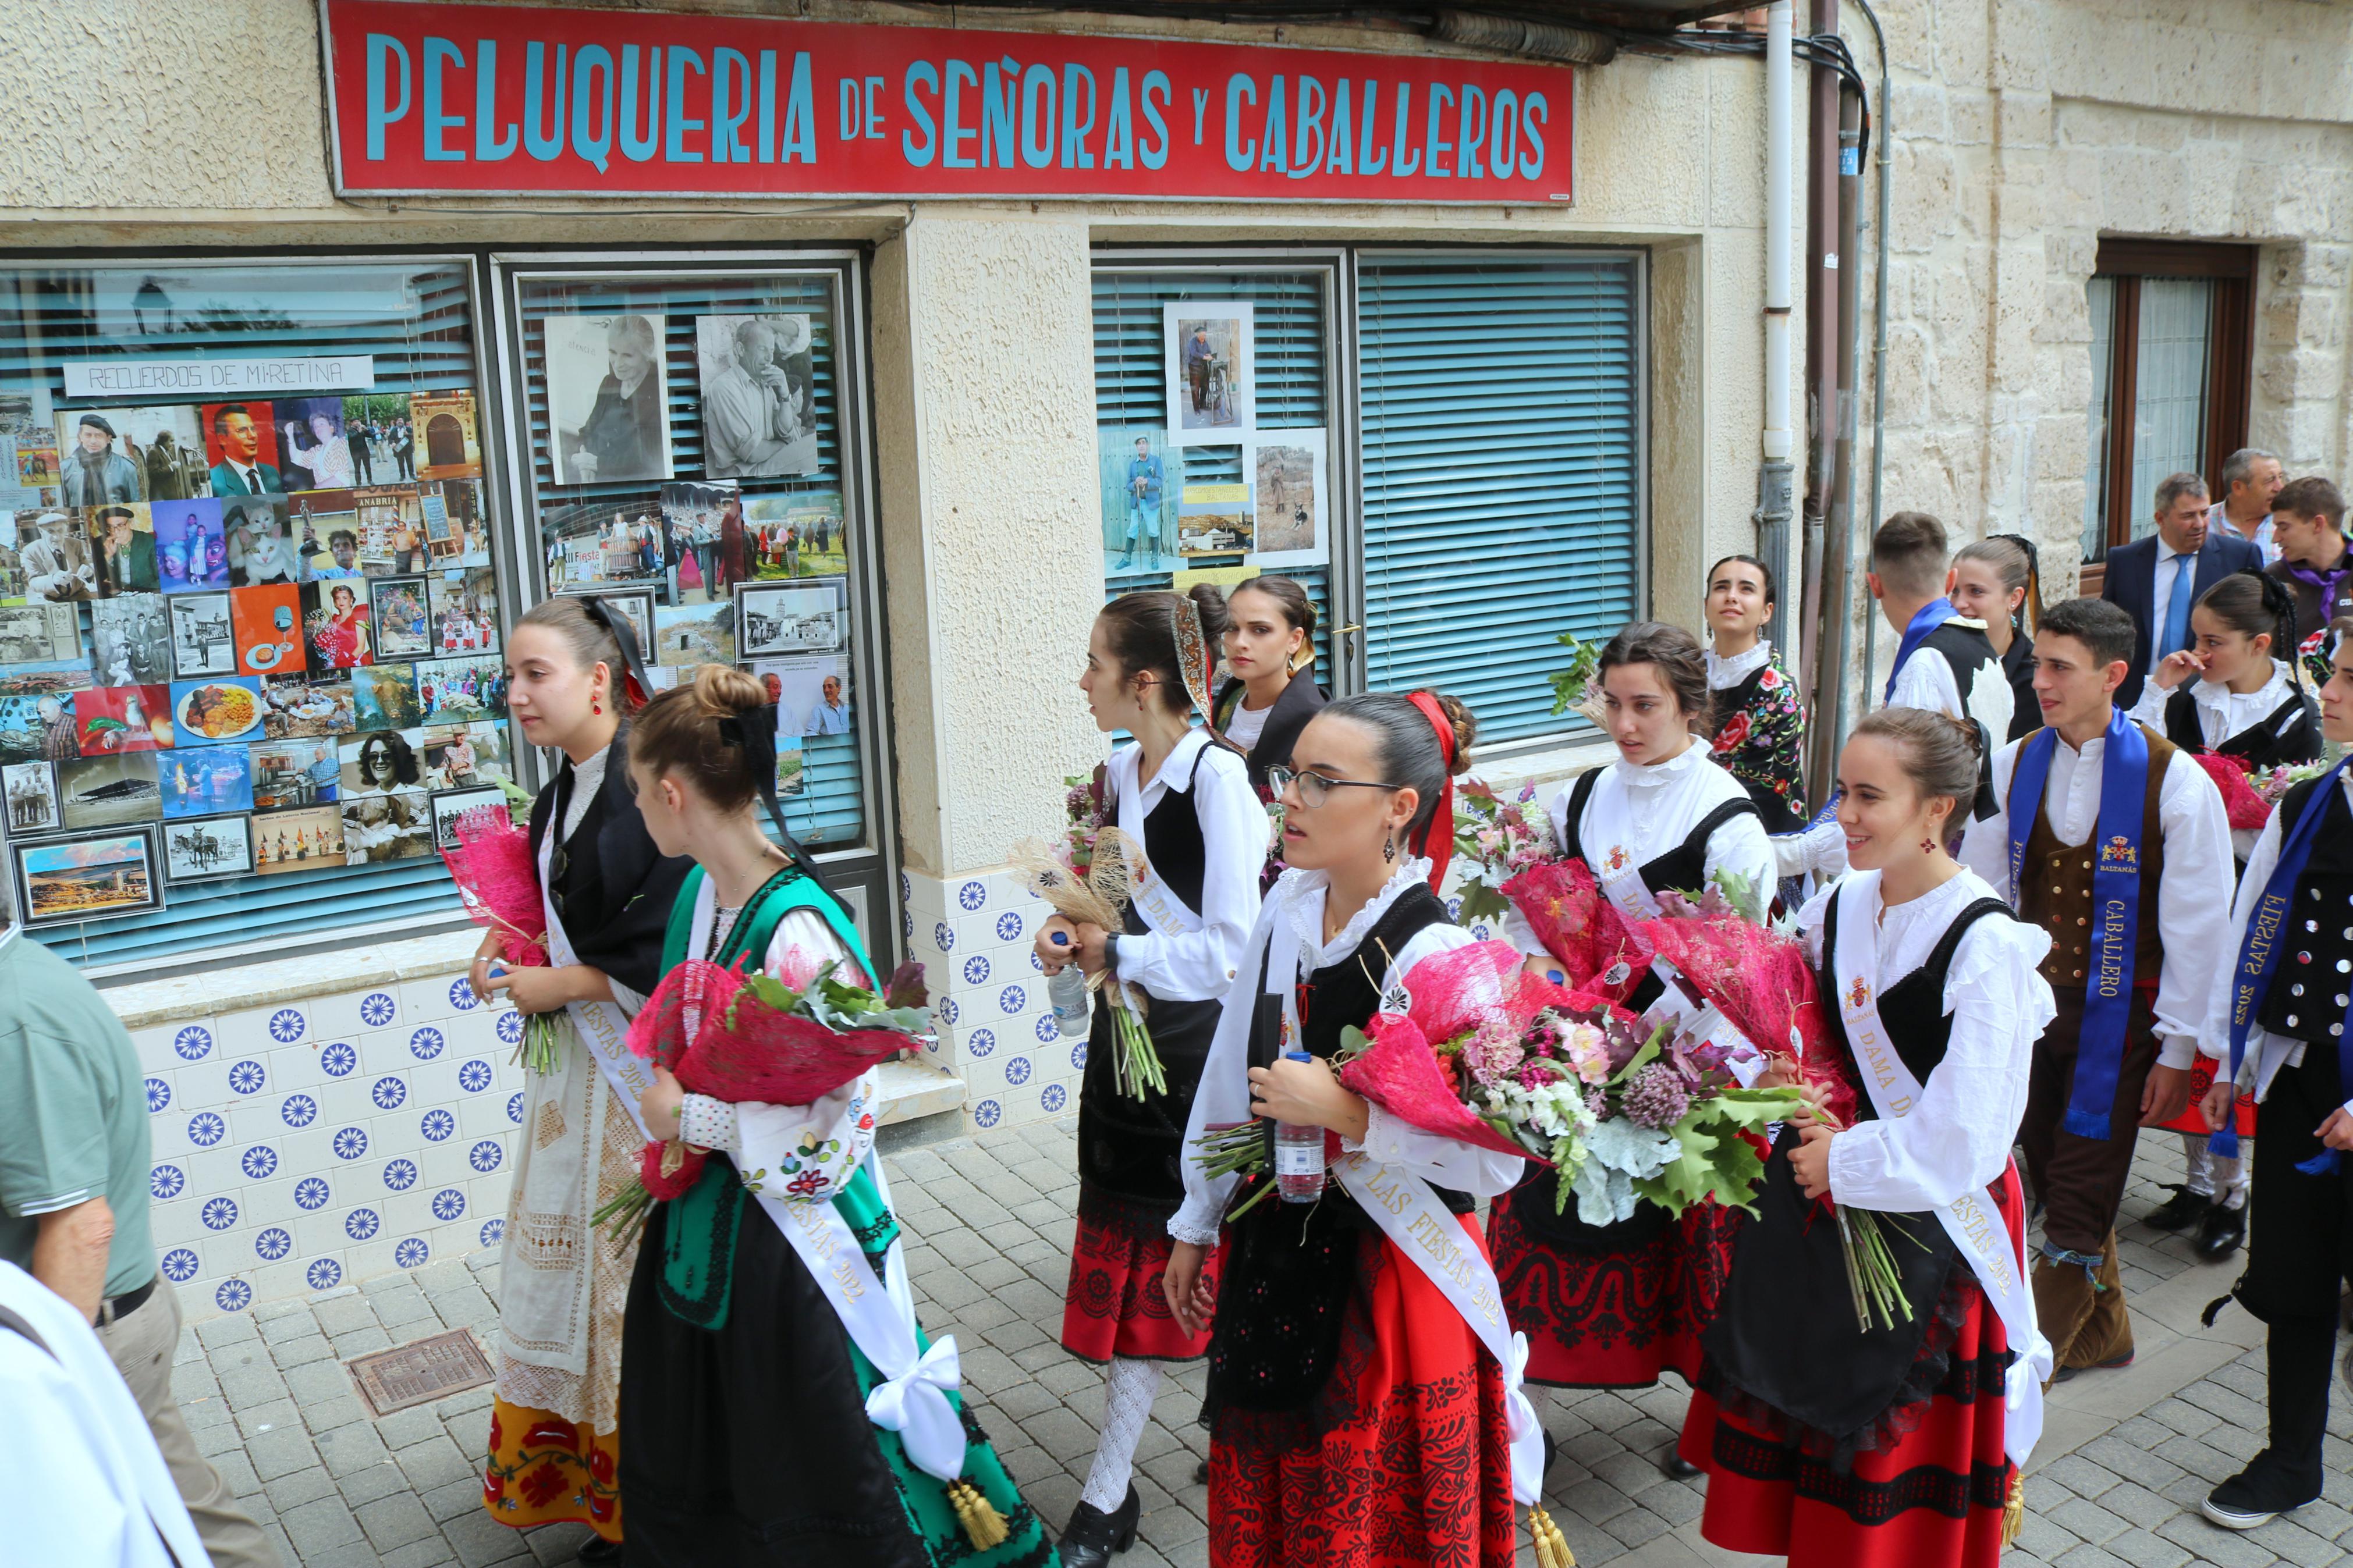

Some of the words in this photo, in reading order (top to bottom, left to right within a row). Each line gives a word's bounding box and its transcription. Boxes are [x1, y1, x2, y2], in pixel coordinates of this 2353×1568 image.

[367, 33, 816, 175] PELUQUERIA
[840, 76, 885, 140] DE
[902, 54, 1171, 170] SEÑORAS
[1193, 88, 1209, 145] Y
[1225, 72, 1548, 180] CABALLEROS
[89, 365, 202, 389] RECUERDOS
[211, 365, 237, 386] DE
[2099, 900, 2125, 997] CABALLERO
[1859, 1030, 1897, 1090] DAMA
[1365, 1163, 1412, 1215] LAS
[1406, 1211, 1475, 1289] FIESTAS
[1471, 1282, 1500, 1327] 2022
[832, 1260, 866, 1304] 2022
[1988, 1254, 2012, 1297] 2022
